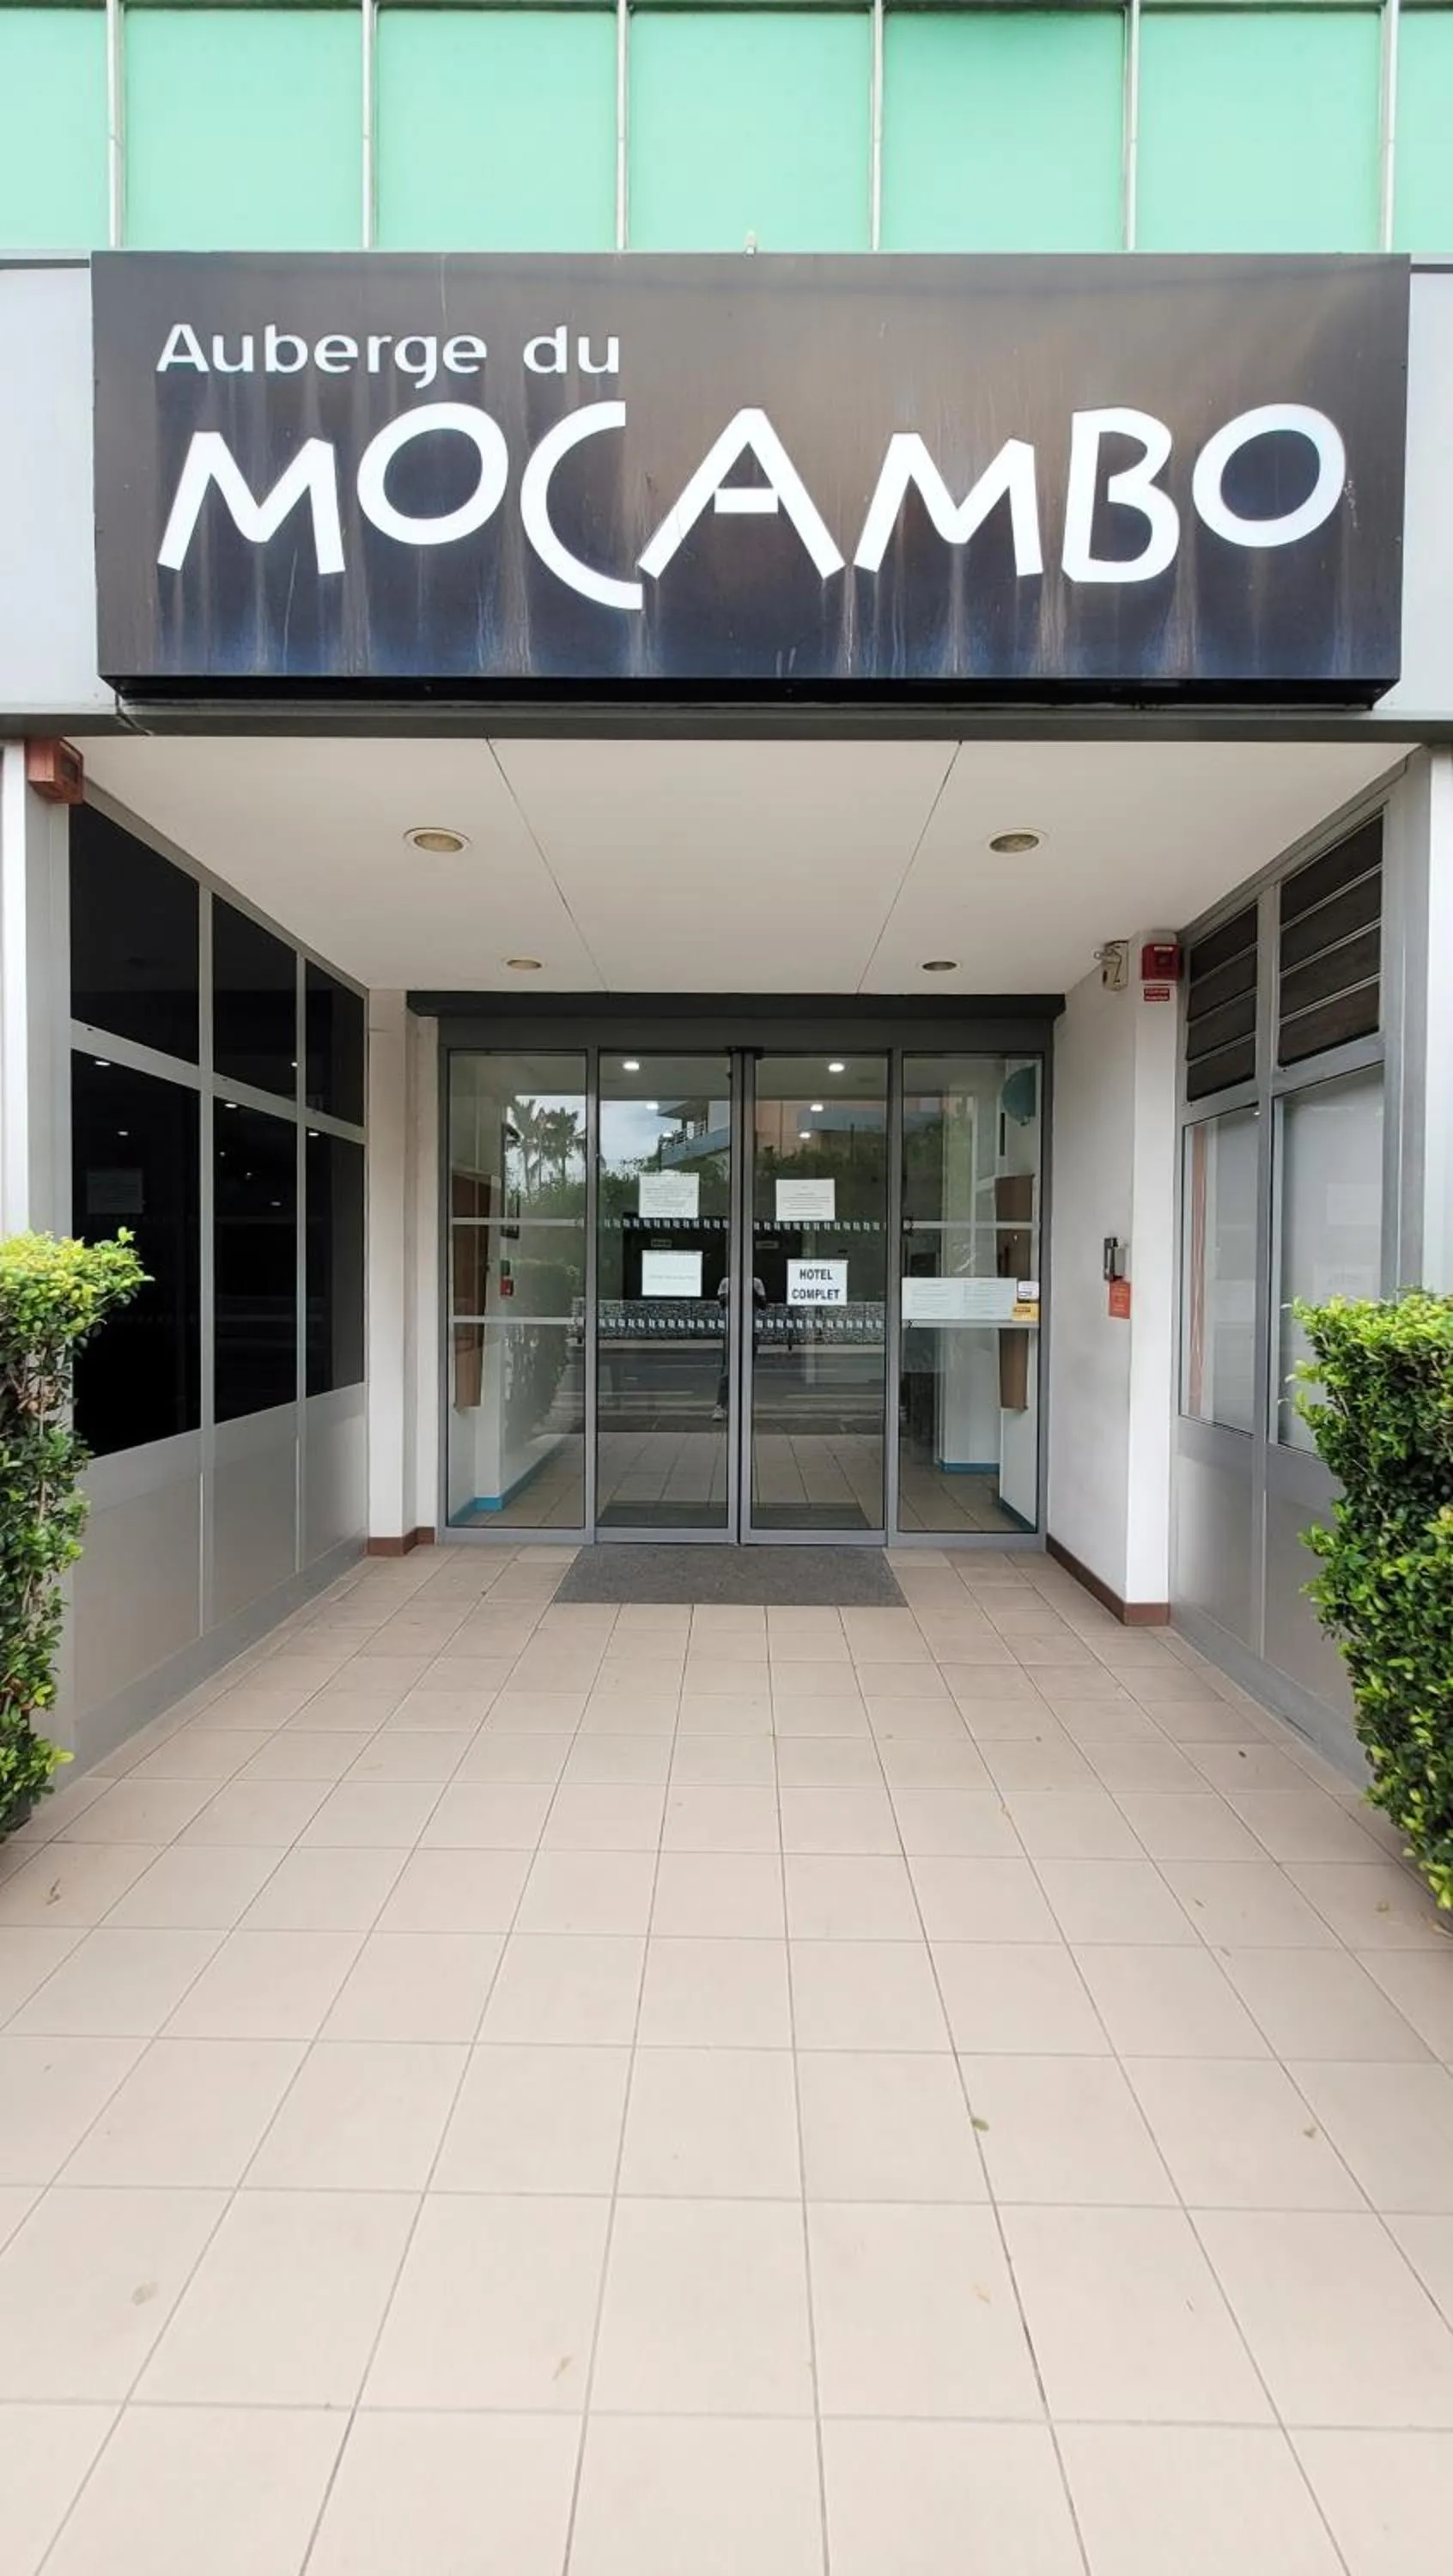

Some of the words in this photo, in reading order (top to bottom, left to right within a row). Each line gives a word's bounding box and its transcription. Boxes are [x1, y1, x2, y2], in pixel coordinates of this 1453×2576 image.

[156, 323, 487, 389] Auberge
[522, 325, 620, 374] du
[157, 400, 1346, 611] MOCAMBO
[799, 1268, 834, 1281] HOTEL
[791, 1288, 841, 1301] COMPLET
